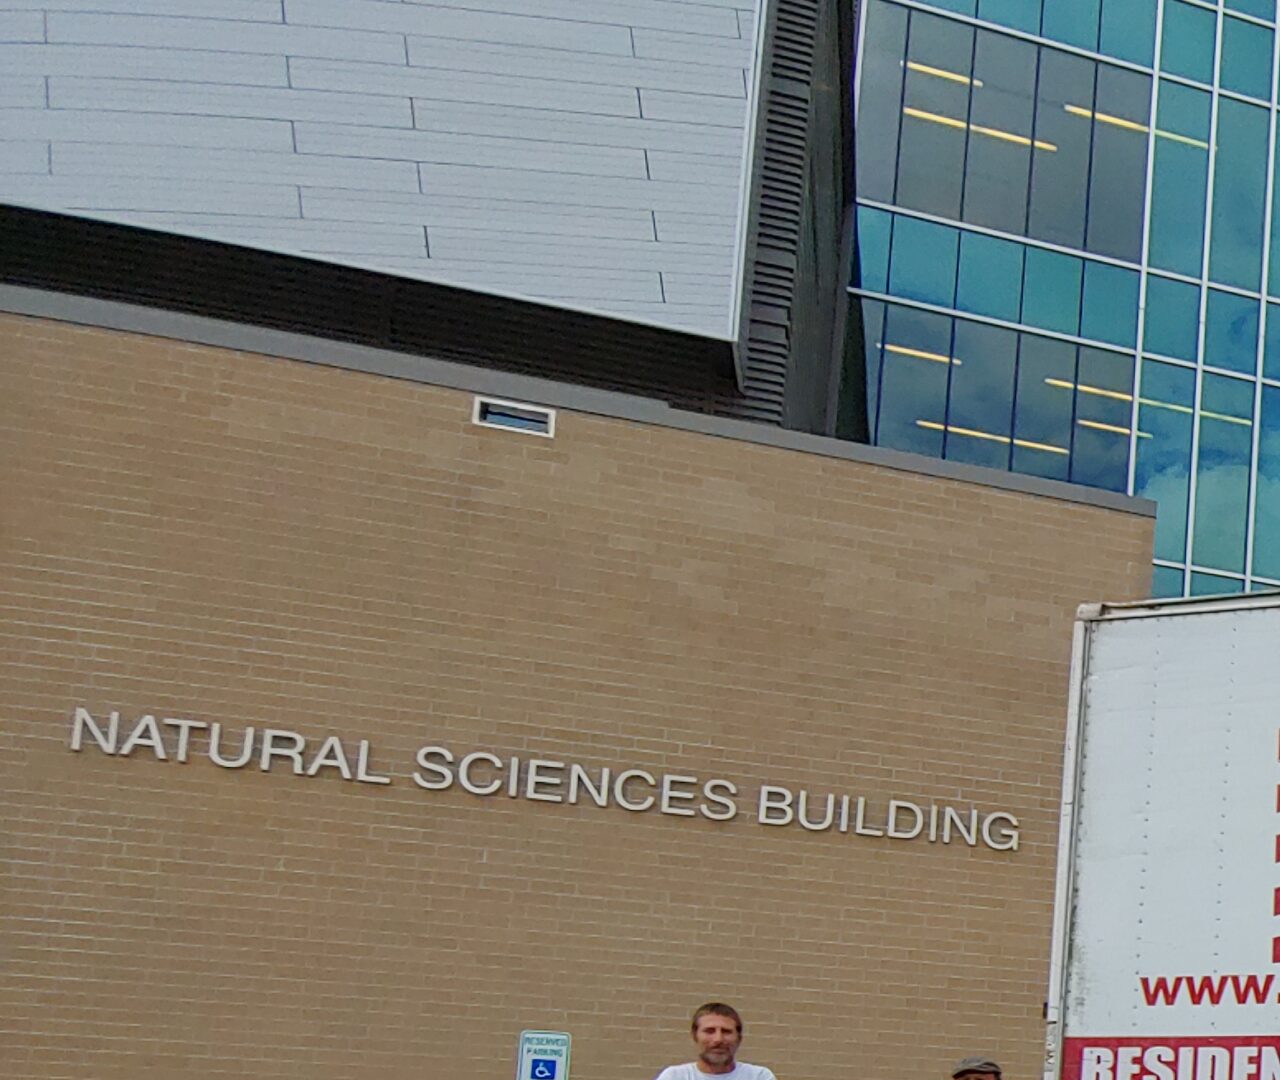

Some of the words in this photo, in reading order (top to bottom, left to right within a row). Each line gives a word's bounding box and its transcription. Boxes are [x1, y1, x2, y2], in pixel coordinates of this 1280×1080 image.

[70, 707, 392, 785] NATURAL
[412, 746, 738, 821] SCIENCES
[758, 785, 1021, 851] BUILDING
